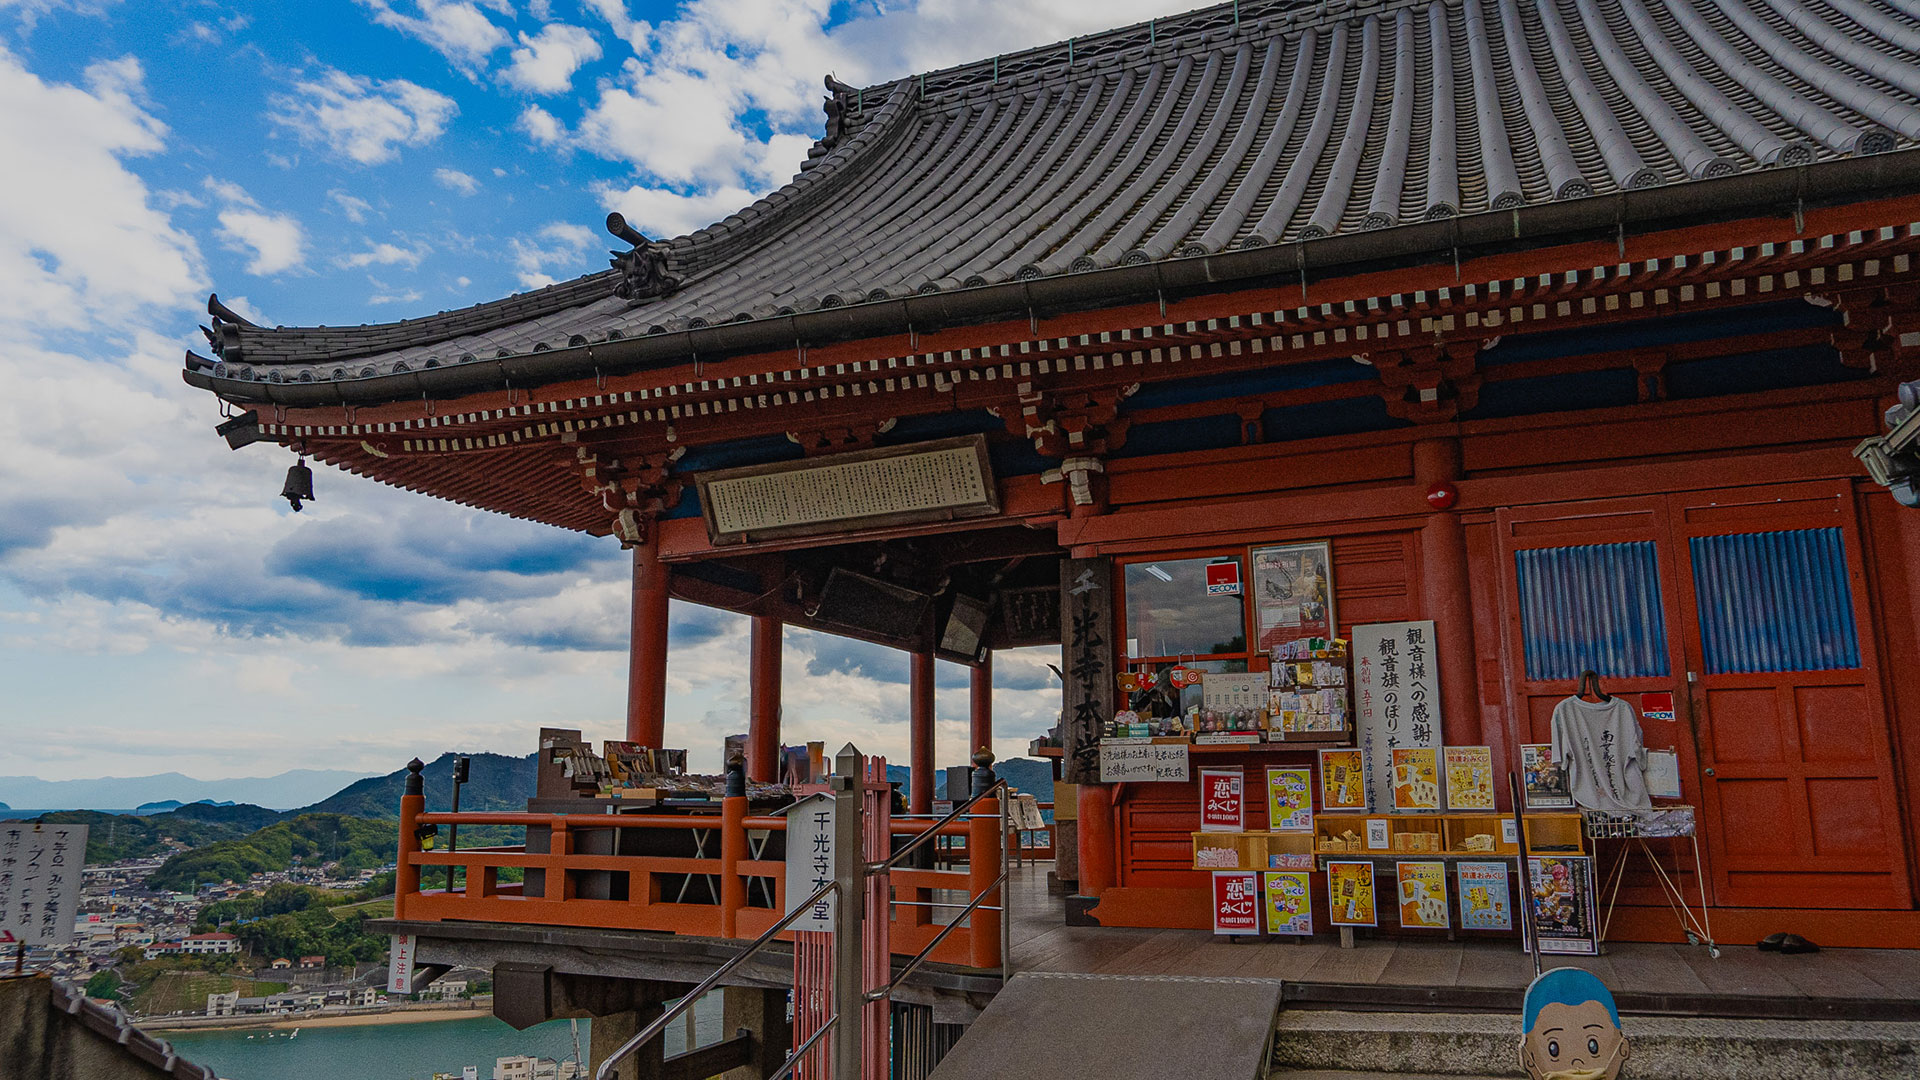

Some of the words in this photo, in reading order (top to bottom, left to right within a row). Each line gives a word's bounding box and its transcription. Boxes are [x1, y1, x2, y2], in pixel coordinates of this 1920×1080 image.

[1209, 584, 1237, 593] SECOM
[1069, 567, 1104, 772] 千光寺本堂
[1405, 628, 1433, 748] 観音様への感謝
[1362, 689, 1373, 717] 五千円
[1213, 779, 1230, 799] 恋
[1207, 799, 1238, 812] みくじ
[812, 811, 830, 921] 千光寺本堂
[1461, 872, 1505, 880] 開運おみくじ
[1226, 879, 1244, 900] 恋
[1220, 901, 1253, 915] みくじ
[395, 934, 409, 990] 頭上注意
